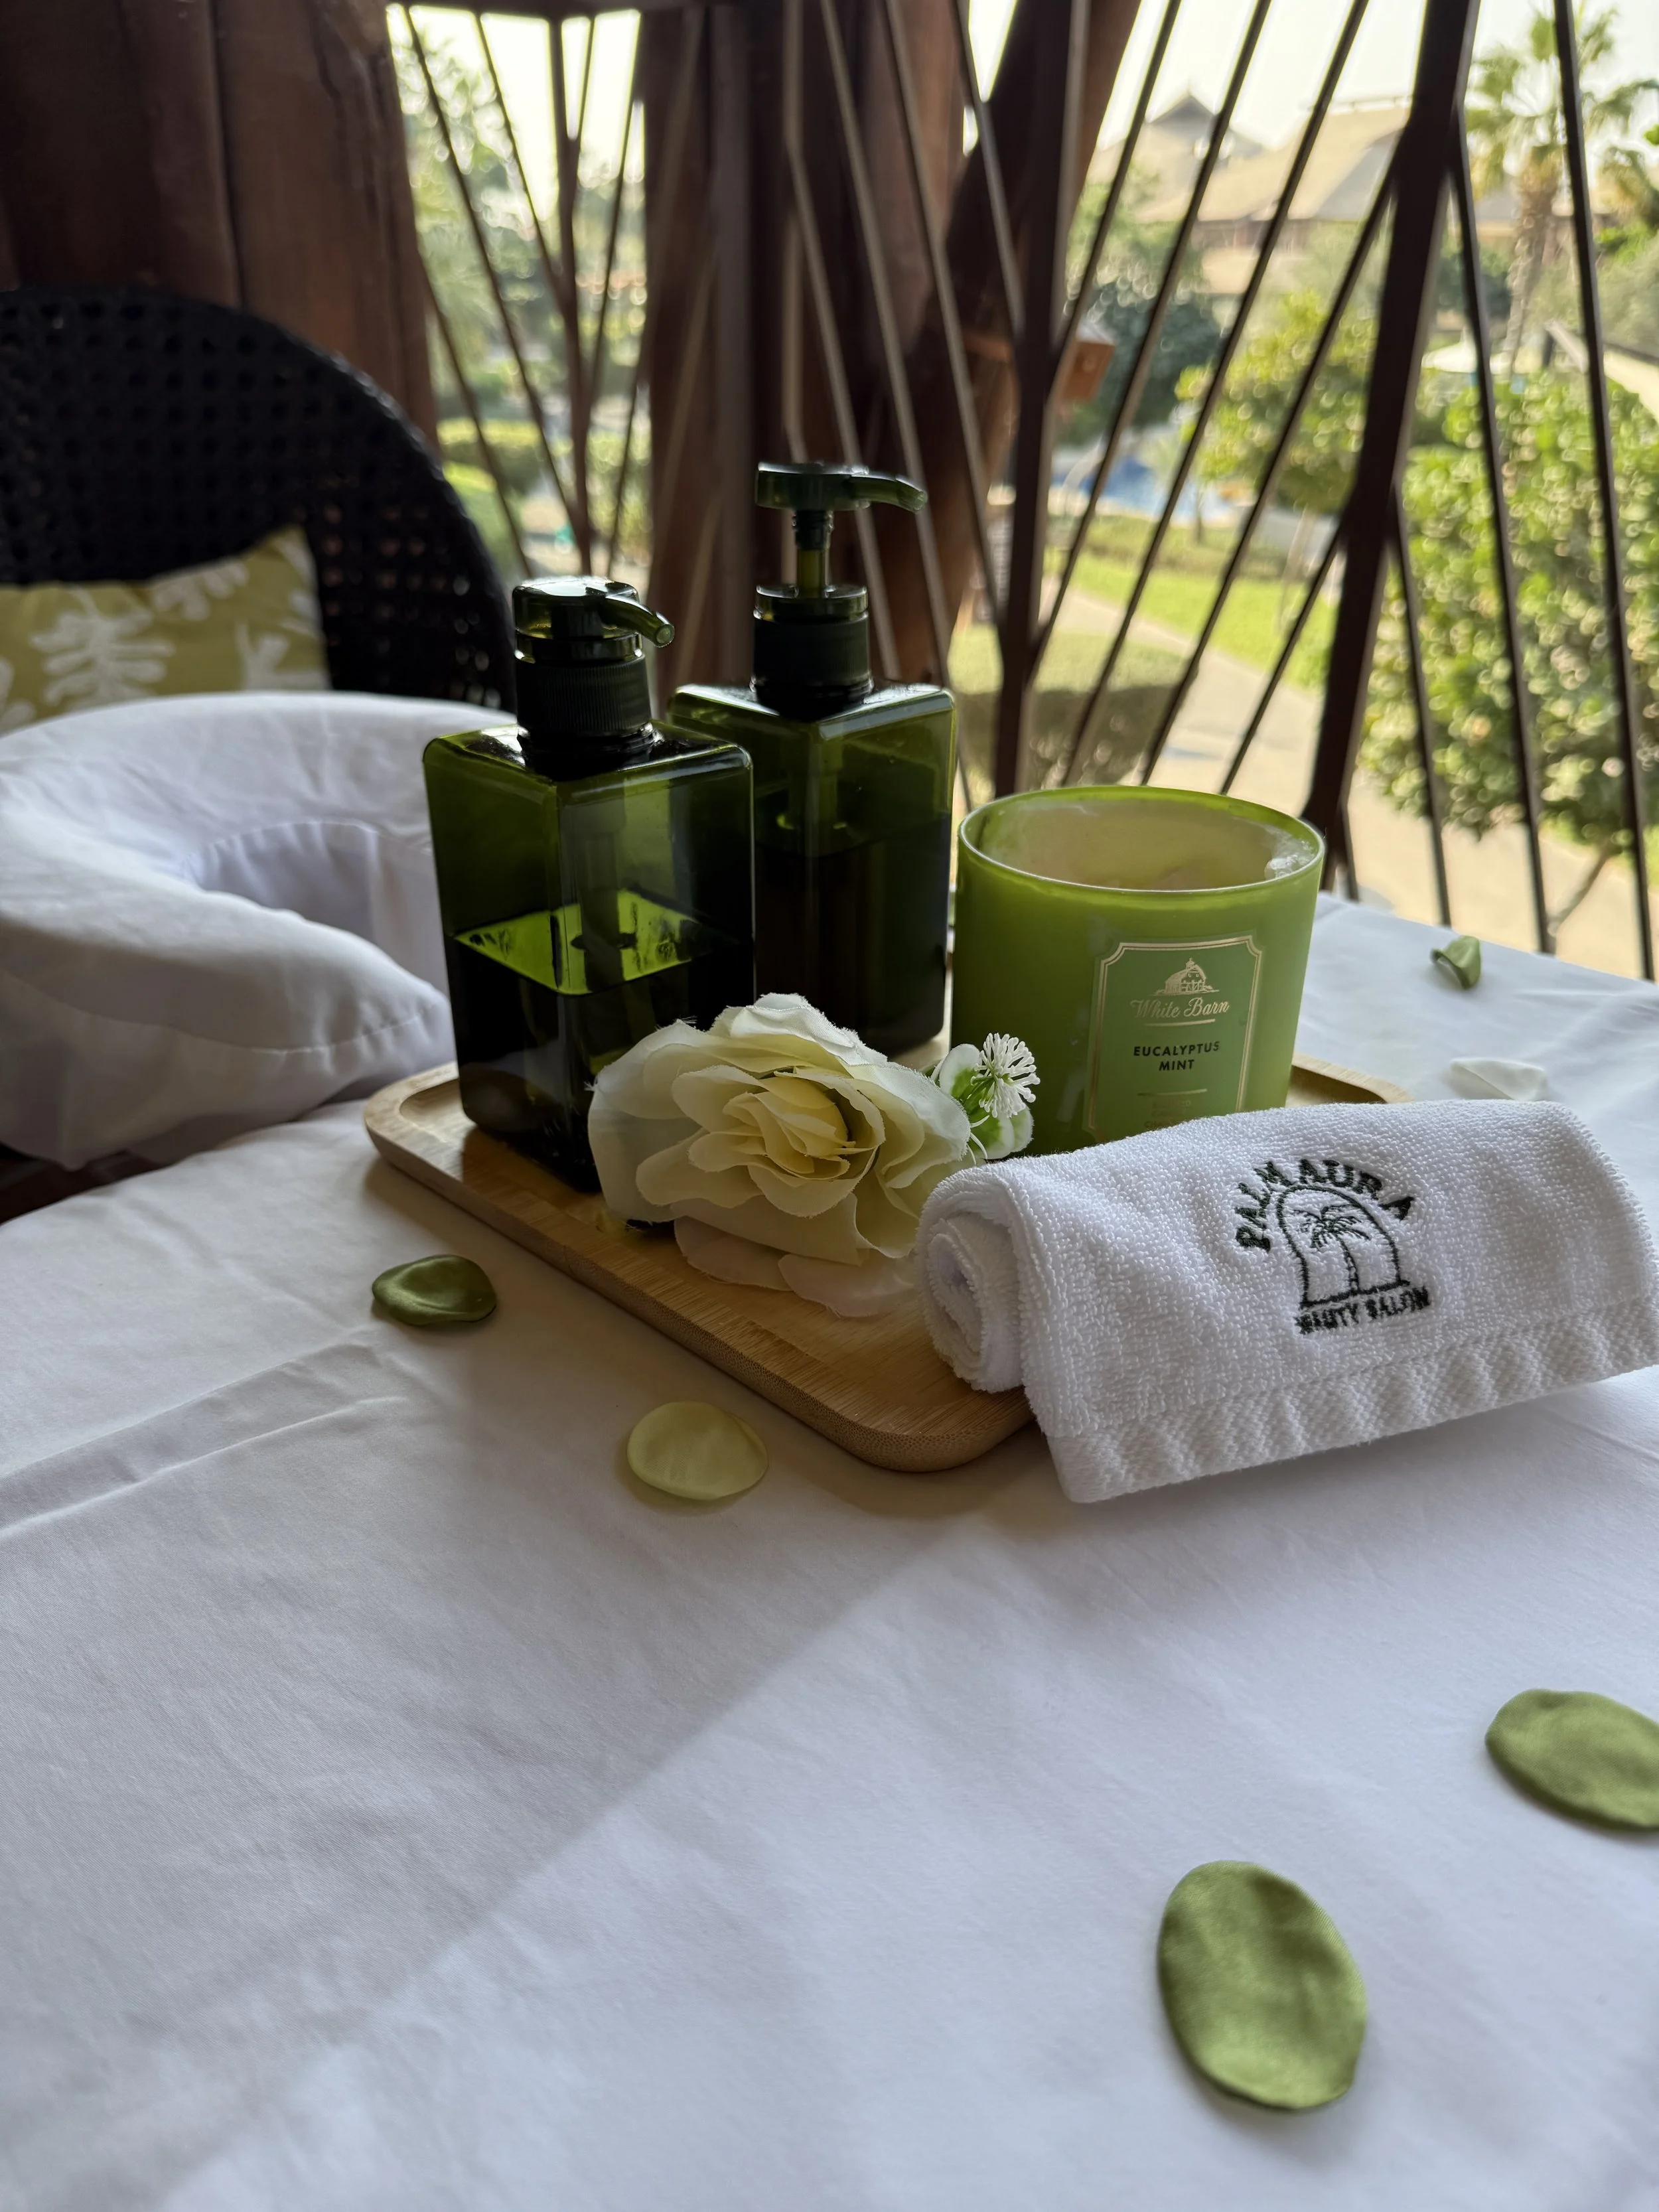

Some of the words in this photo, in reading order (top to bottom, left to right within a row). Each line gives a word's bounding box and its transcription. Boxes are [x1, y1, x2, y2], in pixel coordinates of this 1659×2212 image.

[1130, 999, 1181, 1019] White
[1183, 997, 1230, 1017] Barn
[1133, 1041, 1220, 1057] EUCALYPTUS
[1159, 1059, 1194, 1071] MINT
[1234, 1161, 1293, 1253] PALM
[1299, 1159, 1415, 1220] AURA
